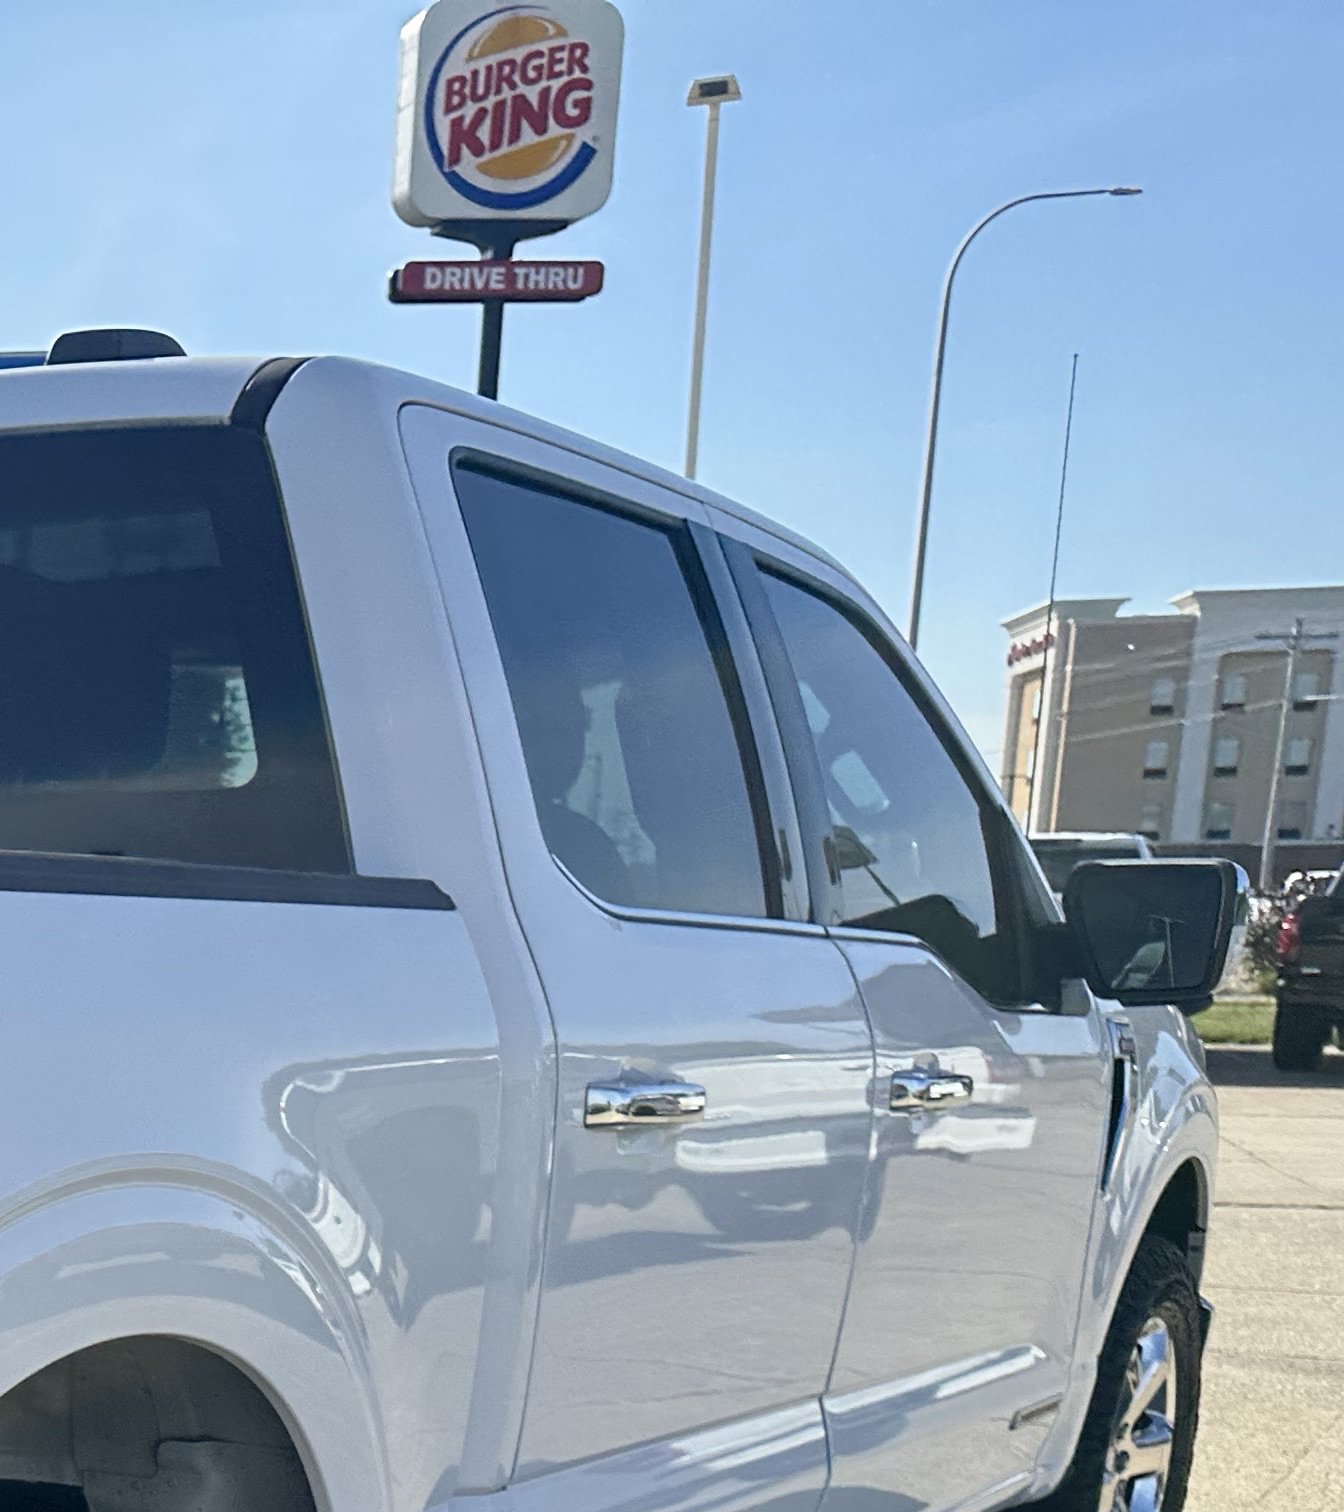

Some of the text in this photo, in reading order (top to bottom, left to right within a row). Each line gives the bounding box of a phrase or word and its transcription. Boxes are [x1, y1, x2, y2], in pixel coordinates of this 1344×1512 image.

[443, 41, 590, 116] BURGER
[446, 76, 594, 171] KING
[423, 265, 585, 291] DRIVE THRU
